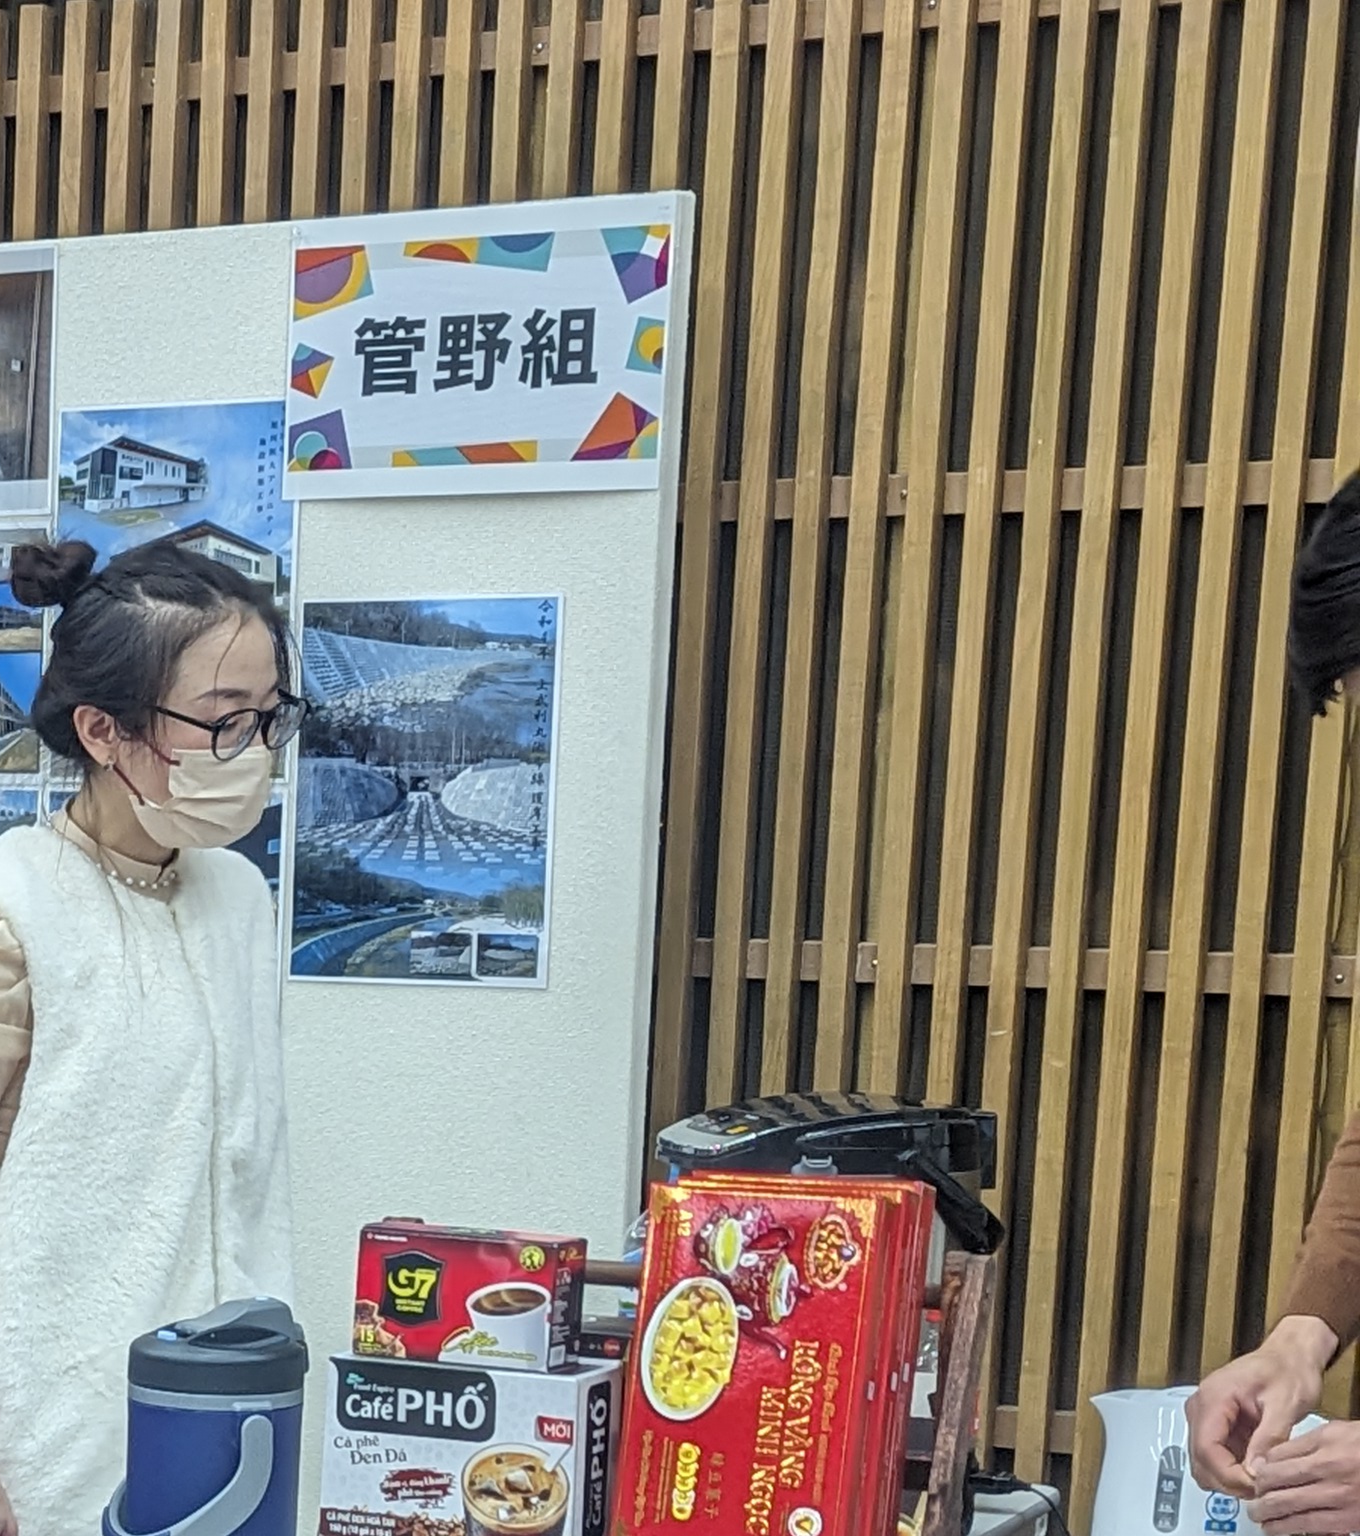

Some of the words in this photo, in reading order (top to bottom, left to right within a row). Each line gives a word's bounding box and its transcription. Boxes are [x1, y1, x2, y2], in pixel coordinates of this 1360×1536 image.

[354, 307, 598, 397] 管野組
[388, 1267, 437, 1300] G7
[359, 1327, 375, 1342] 15
[345, 1394, 393, 1420] Café
[396, 1382, 486, 1430] PHỐ
